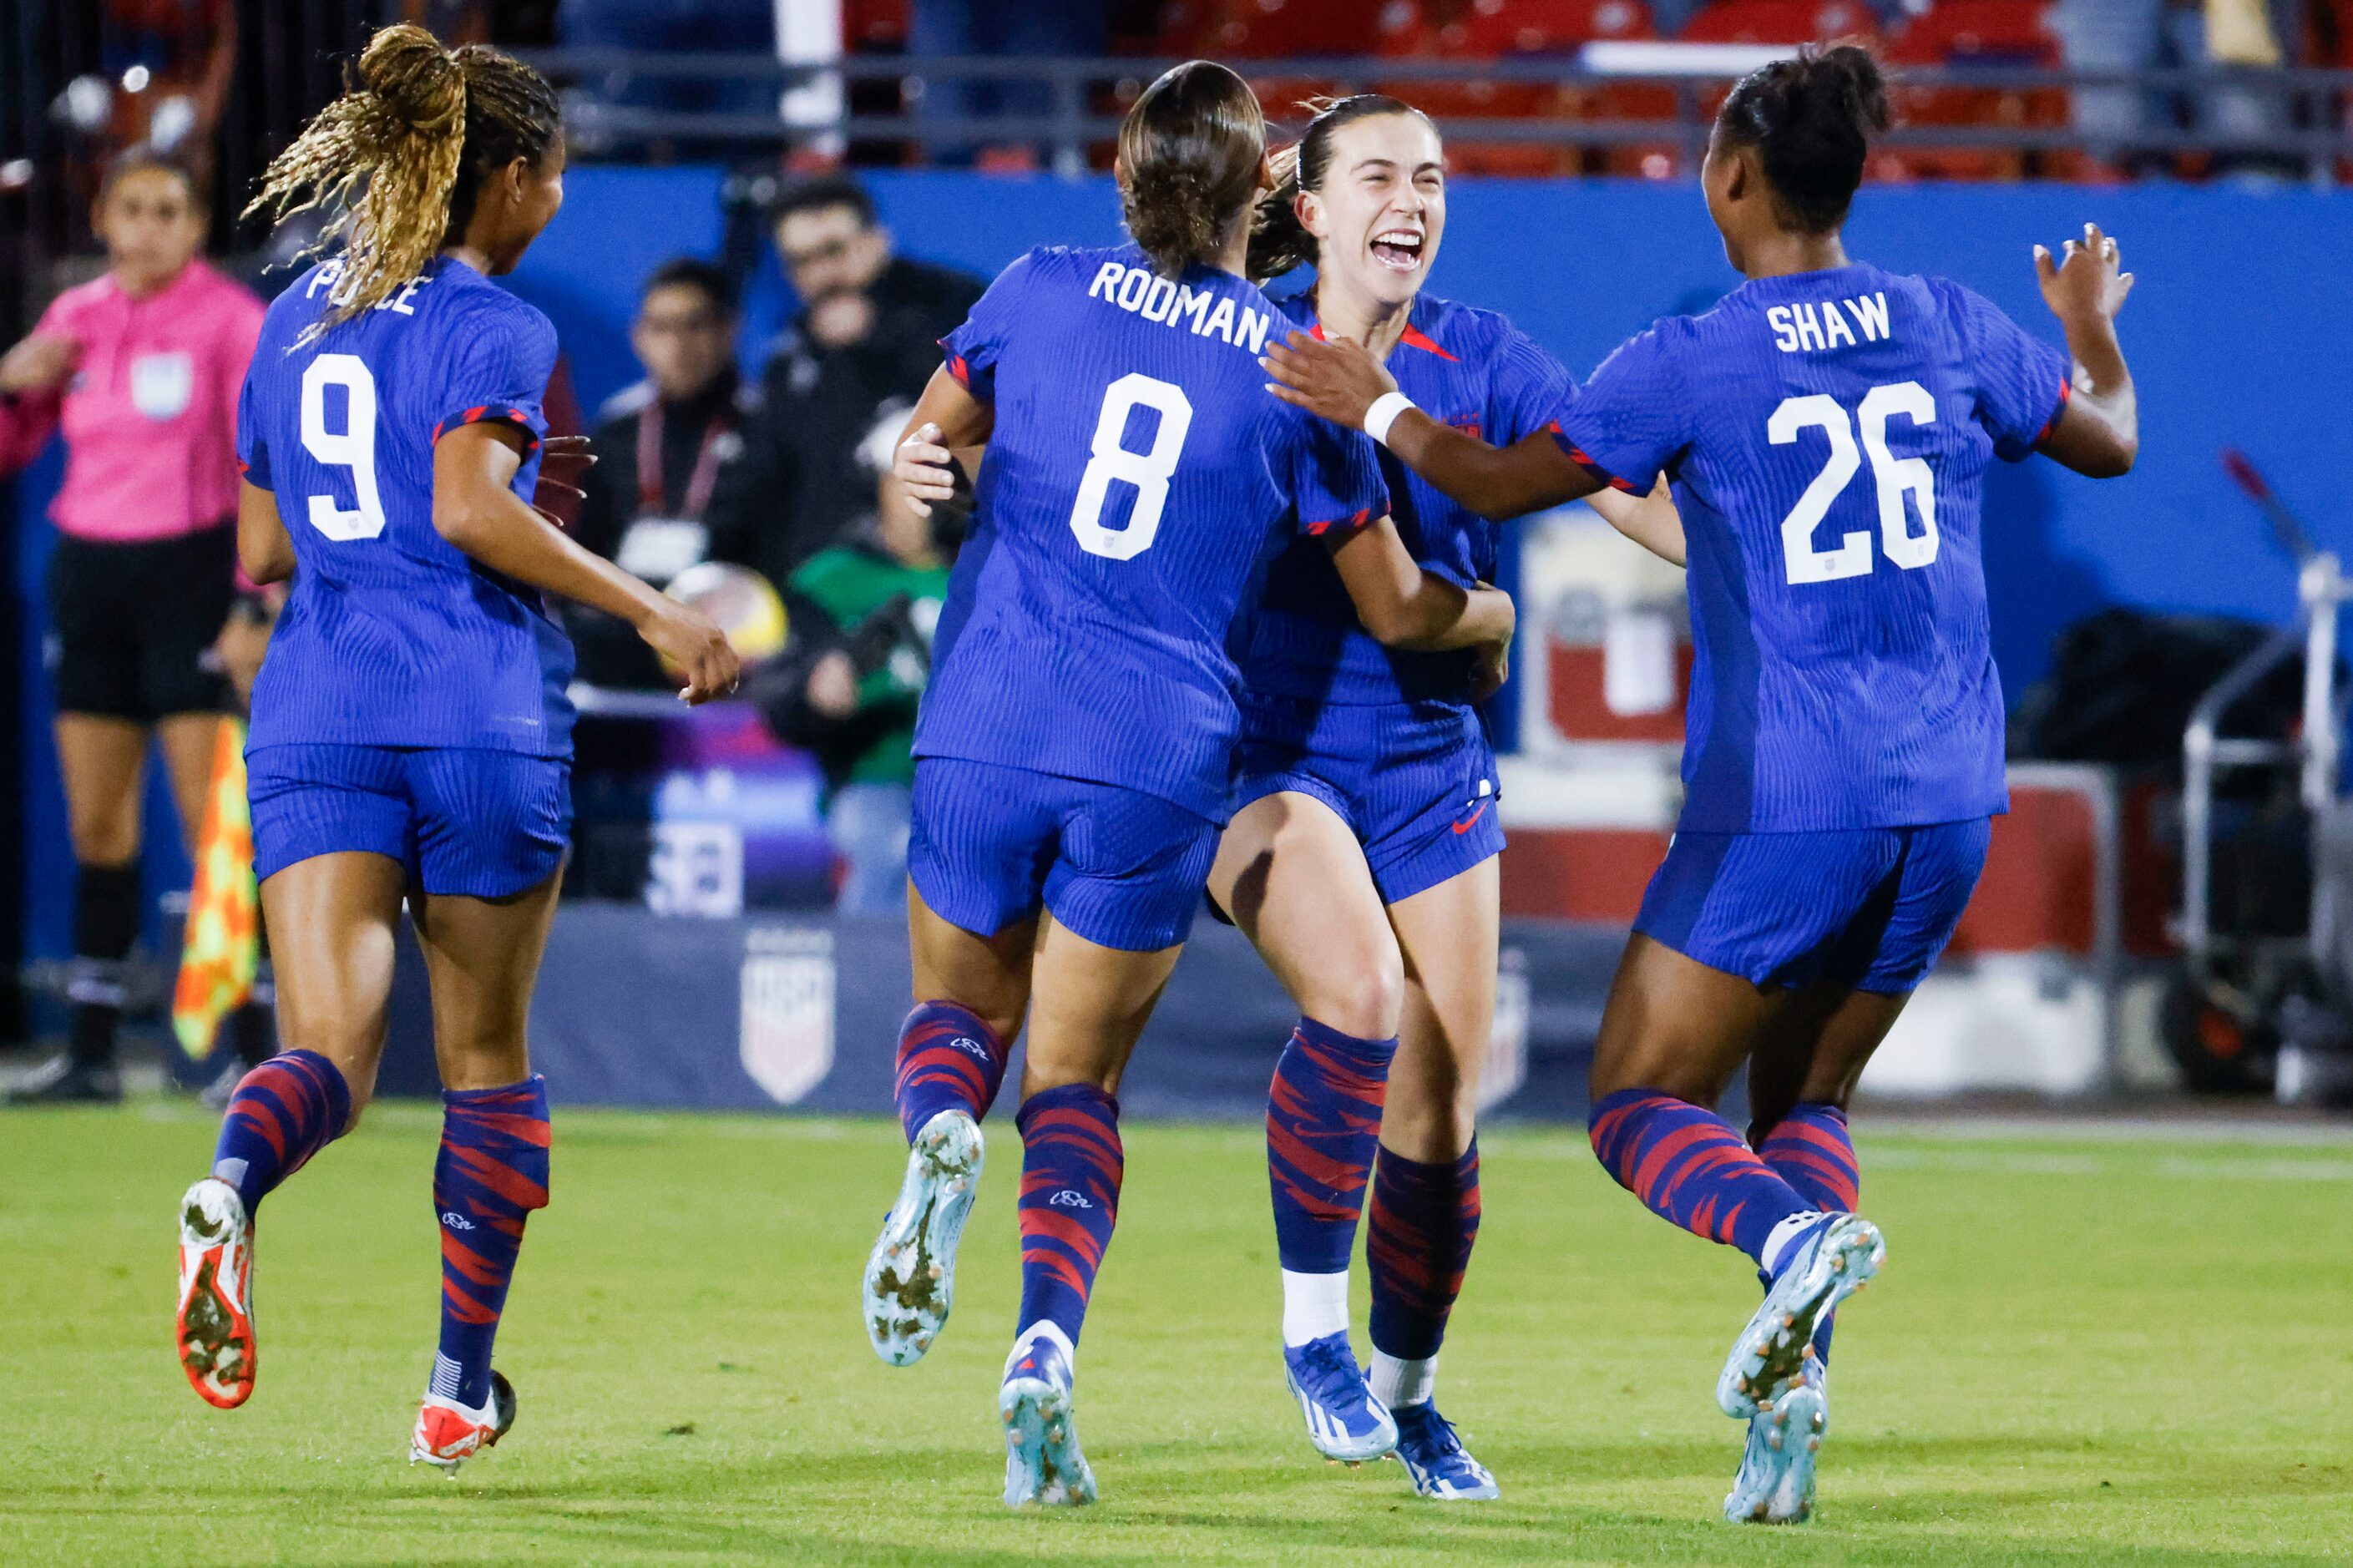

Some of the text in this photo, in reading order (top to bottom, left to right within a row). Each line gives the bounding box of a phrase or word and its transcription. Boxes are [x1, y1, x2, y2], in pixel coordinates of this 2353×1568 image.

[1088, 261, 1269, 355] RODMAN
[1766, 291, 1890, 352] SHAW
[301, 353, 386, 541] 9
[1069, 372, 1193, 561] 8
[1767, 380, 1940, 584] 26
